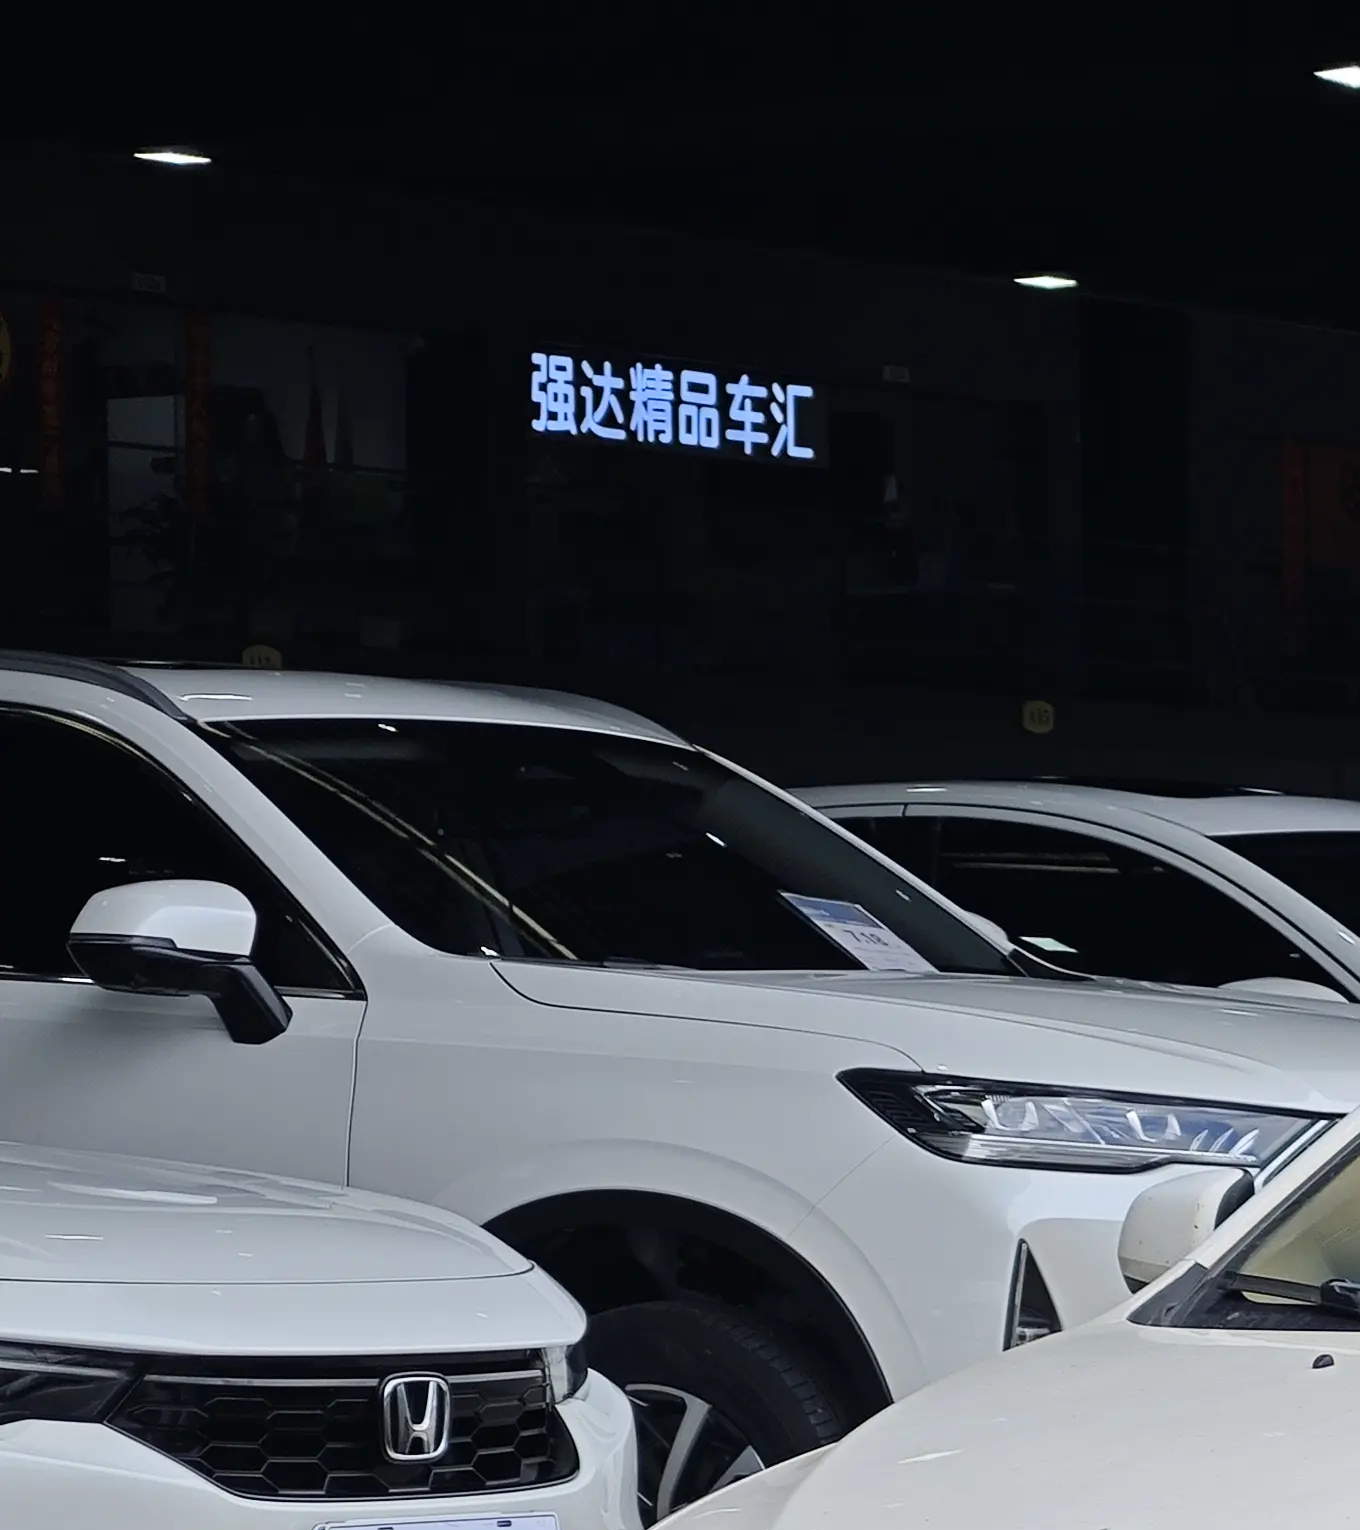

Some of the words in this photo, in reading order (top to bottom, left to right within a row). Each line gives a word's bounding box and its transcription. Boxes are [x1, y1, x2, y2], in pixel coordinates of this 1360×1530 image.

[531, 352, 815, 459] 强达精品车汇
[387, 545, 557, 604] 好友二手车
